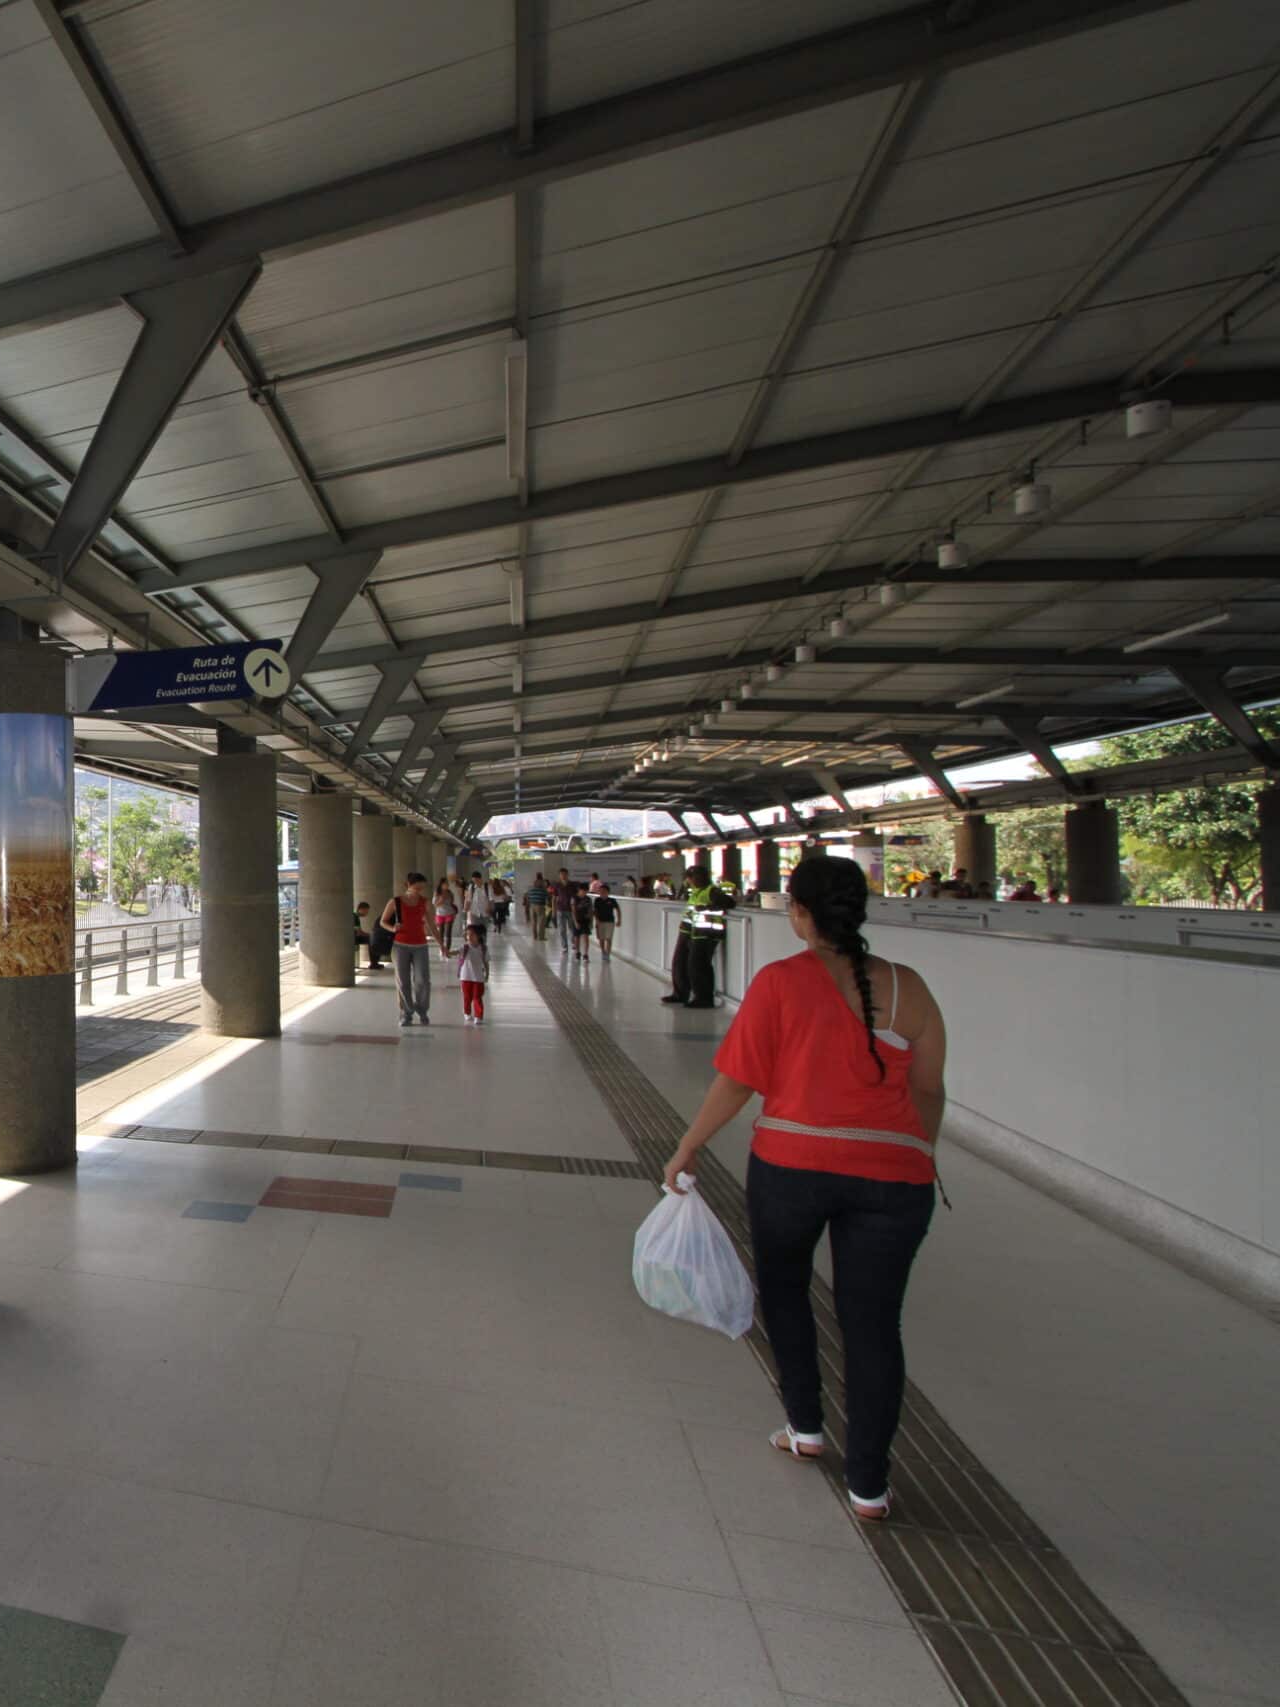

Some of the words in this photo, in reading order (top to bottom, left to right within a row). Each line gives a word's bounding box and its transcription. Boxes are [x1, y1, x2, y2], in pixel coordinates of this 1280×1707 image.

[193, 656, 218, 668] Ruta
[221, 655, 236, 666] de
[176, 669, 237, 683] Evacuación
[156, 685, 206, 698] Evacuation
[207, 683, 237, 693] Route
